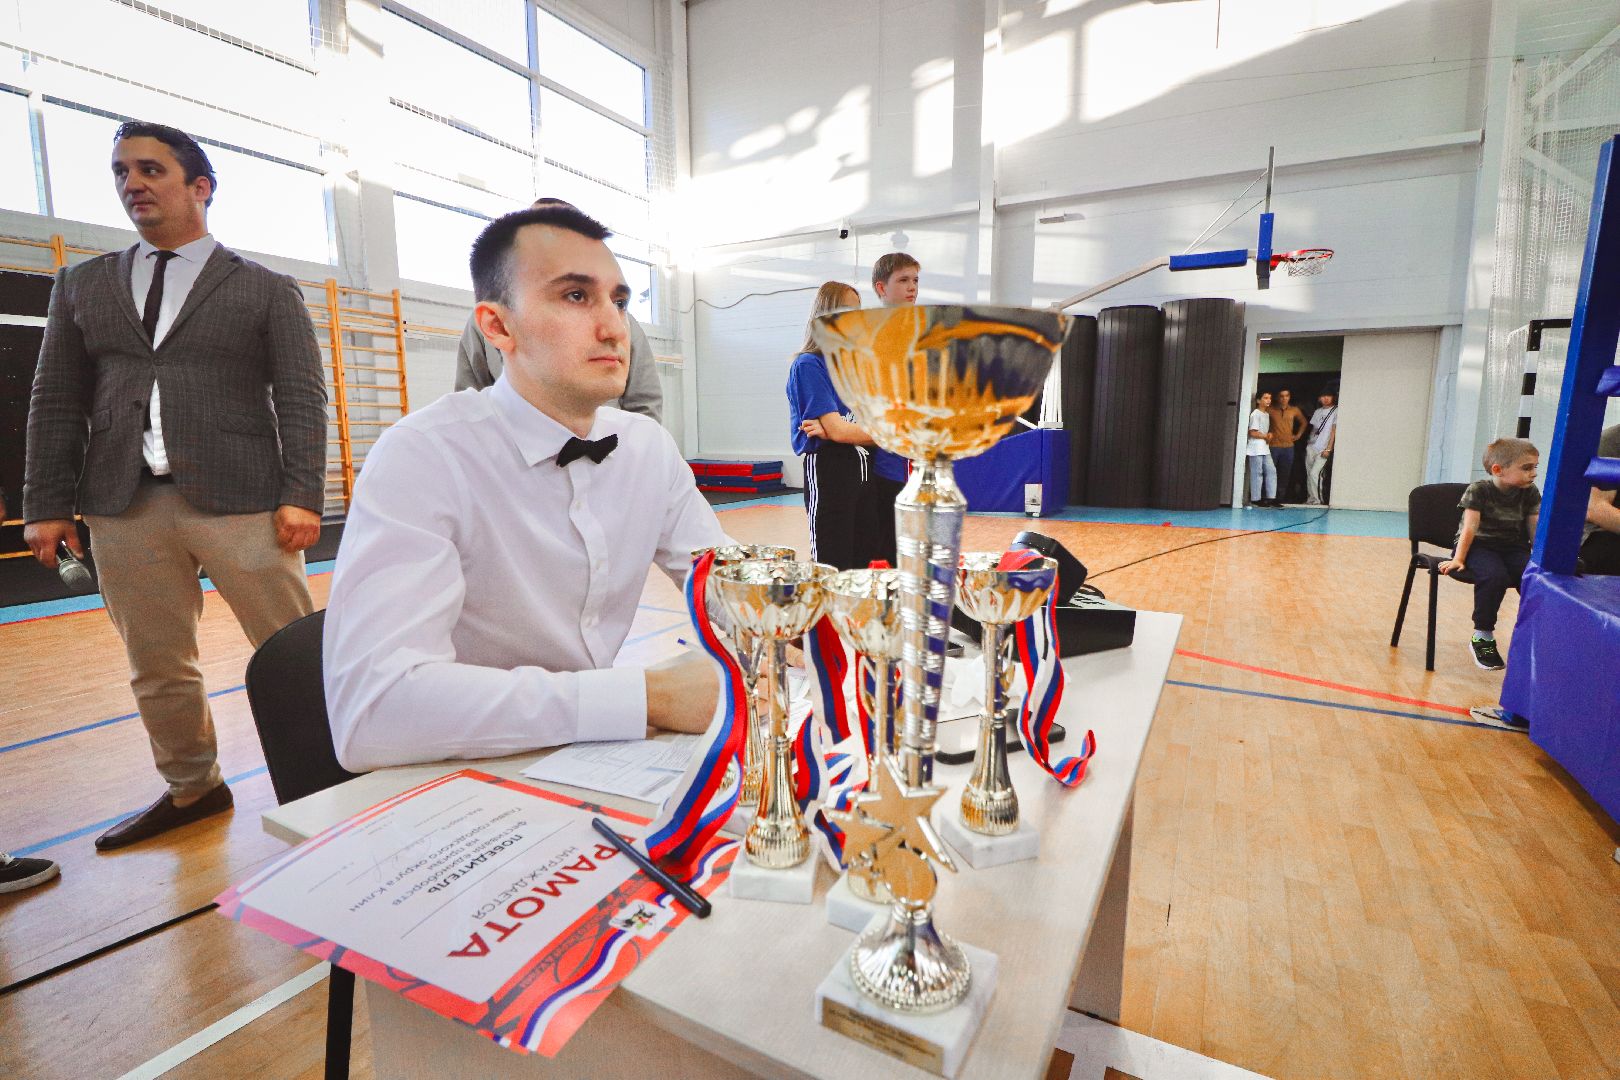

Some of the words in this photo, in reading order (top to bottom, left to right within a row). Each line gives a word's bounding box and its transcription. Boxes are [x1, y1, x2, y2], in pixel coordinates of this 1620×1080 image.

[385, 858, 429, 887] округа
[428, 833, 523, 894] ПОБЕДИТЕЛЬ
[471, 845, 578, 920] НАГРАЖДАЕТСЯ
[349, 886, 388, 913] Клин
